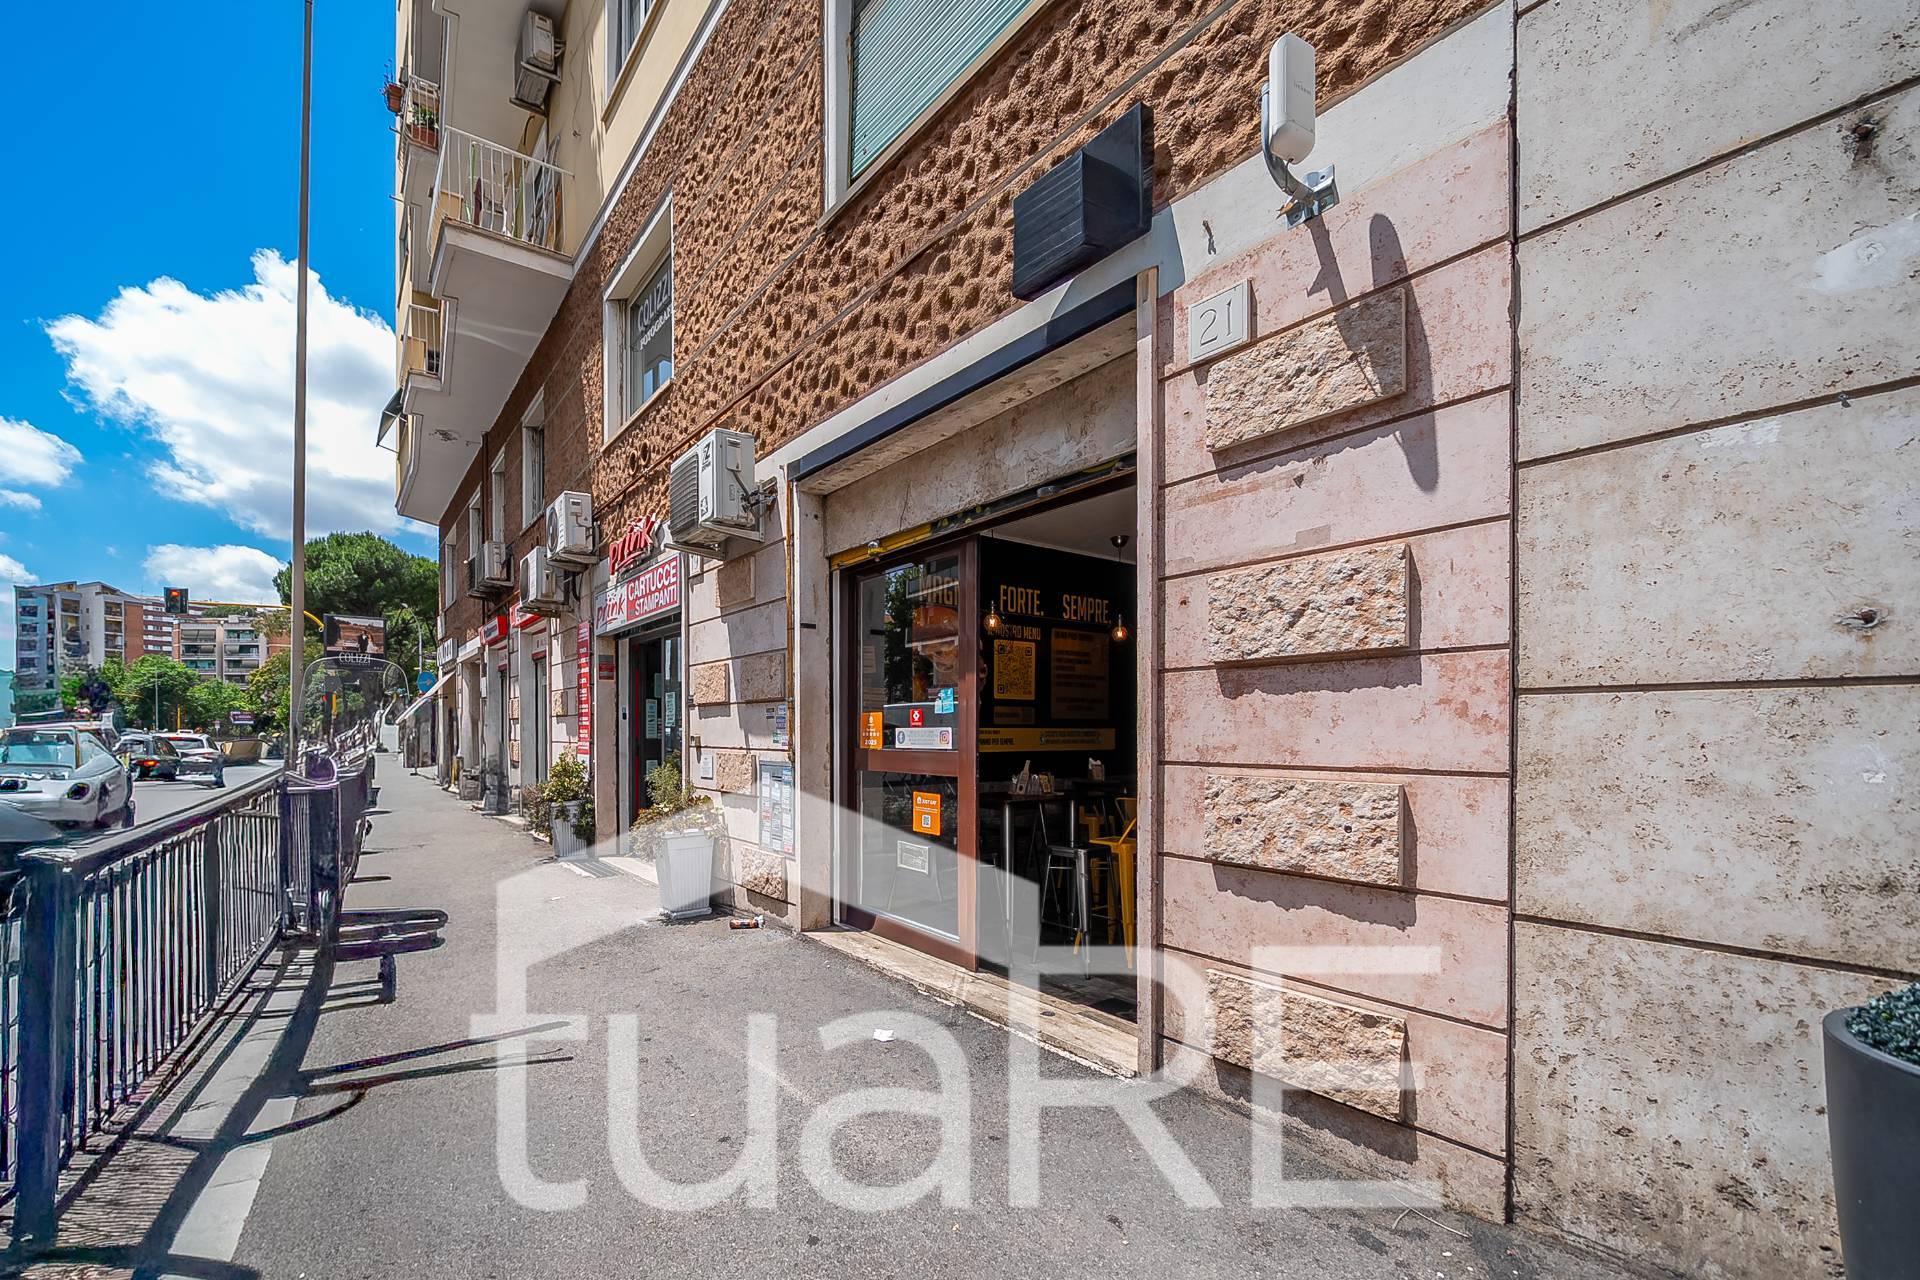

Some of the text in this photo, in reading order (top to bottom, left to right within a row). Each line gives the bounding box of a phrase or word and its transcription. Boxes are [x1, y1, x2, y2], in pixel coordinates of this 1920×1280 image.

[637, 269, 671, 331] COLIZZI
[1199, 297, 1233, 346] 21
[628, 560, 677, 600] CARTUCCE
[635, 584, 677, 616] STAMPANTI
[339, 652, 371, 664] COLIZZI
